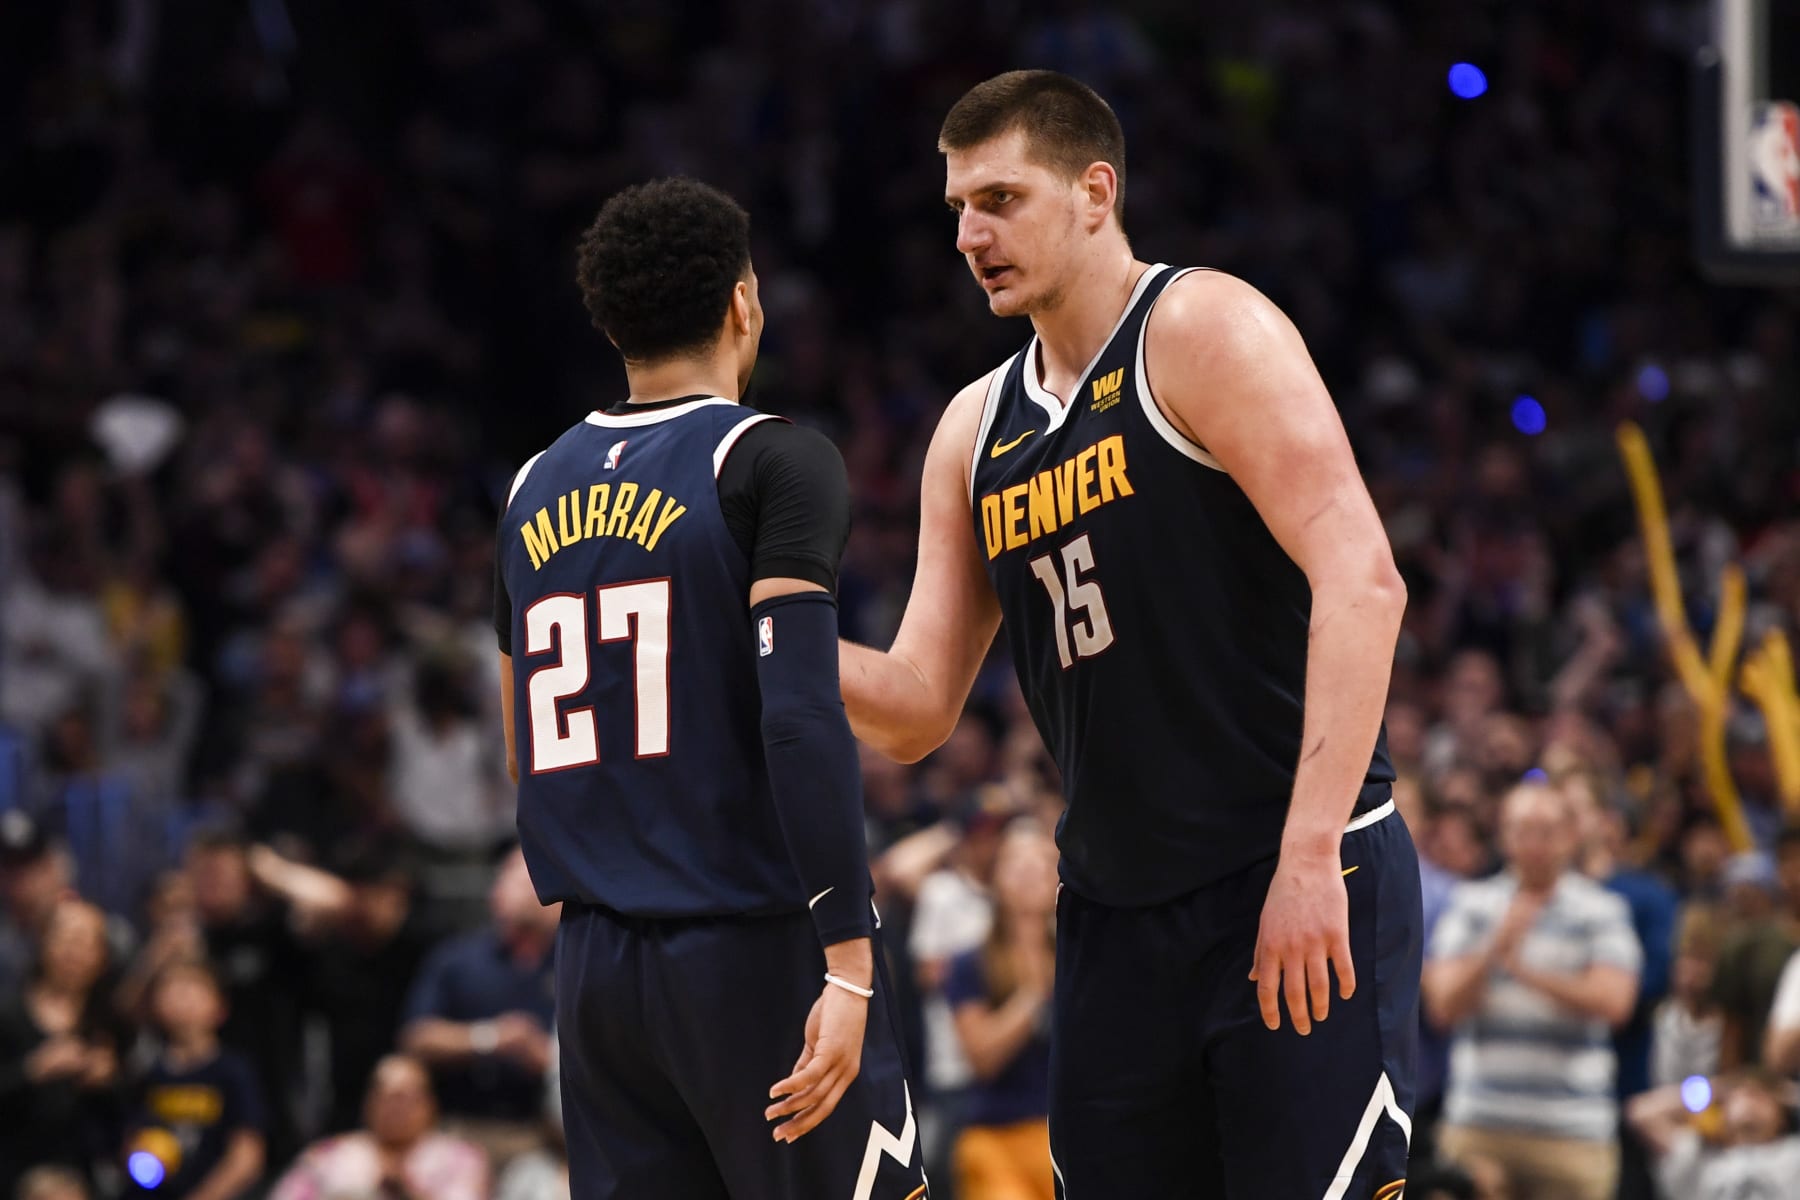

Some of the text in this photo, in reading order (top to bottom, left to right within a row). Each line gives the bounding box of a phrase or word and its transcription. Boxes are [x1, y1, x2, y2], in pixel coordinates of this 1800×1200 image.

[1090, 389, 1121, 411] WESTERN
[1092, 367, 1124, 401] WU
[1099, 396, 1121, 413] UNION
[520, 482, 687, 571] MURRAY
[981, 434, 1135, 560] DENVER
[1028, 531, 1115, 670] 15
[524, 576, 671, 774] 27
